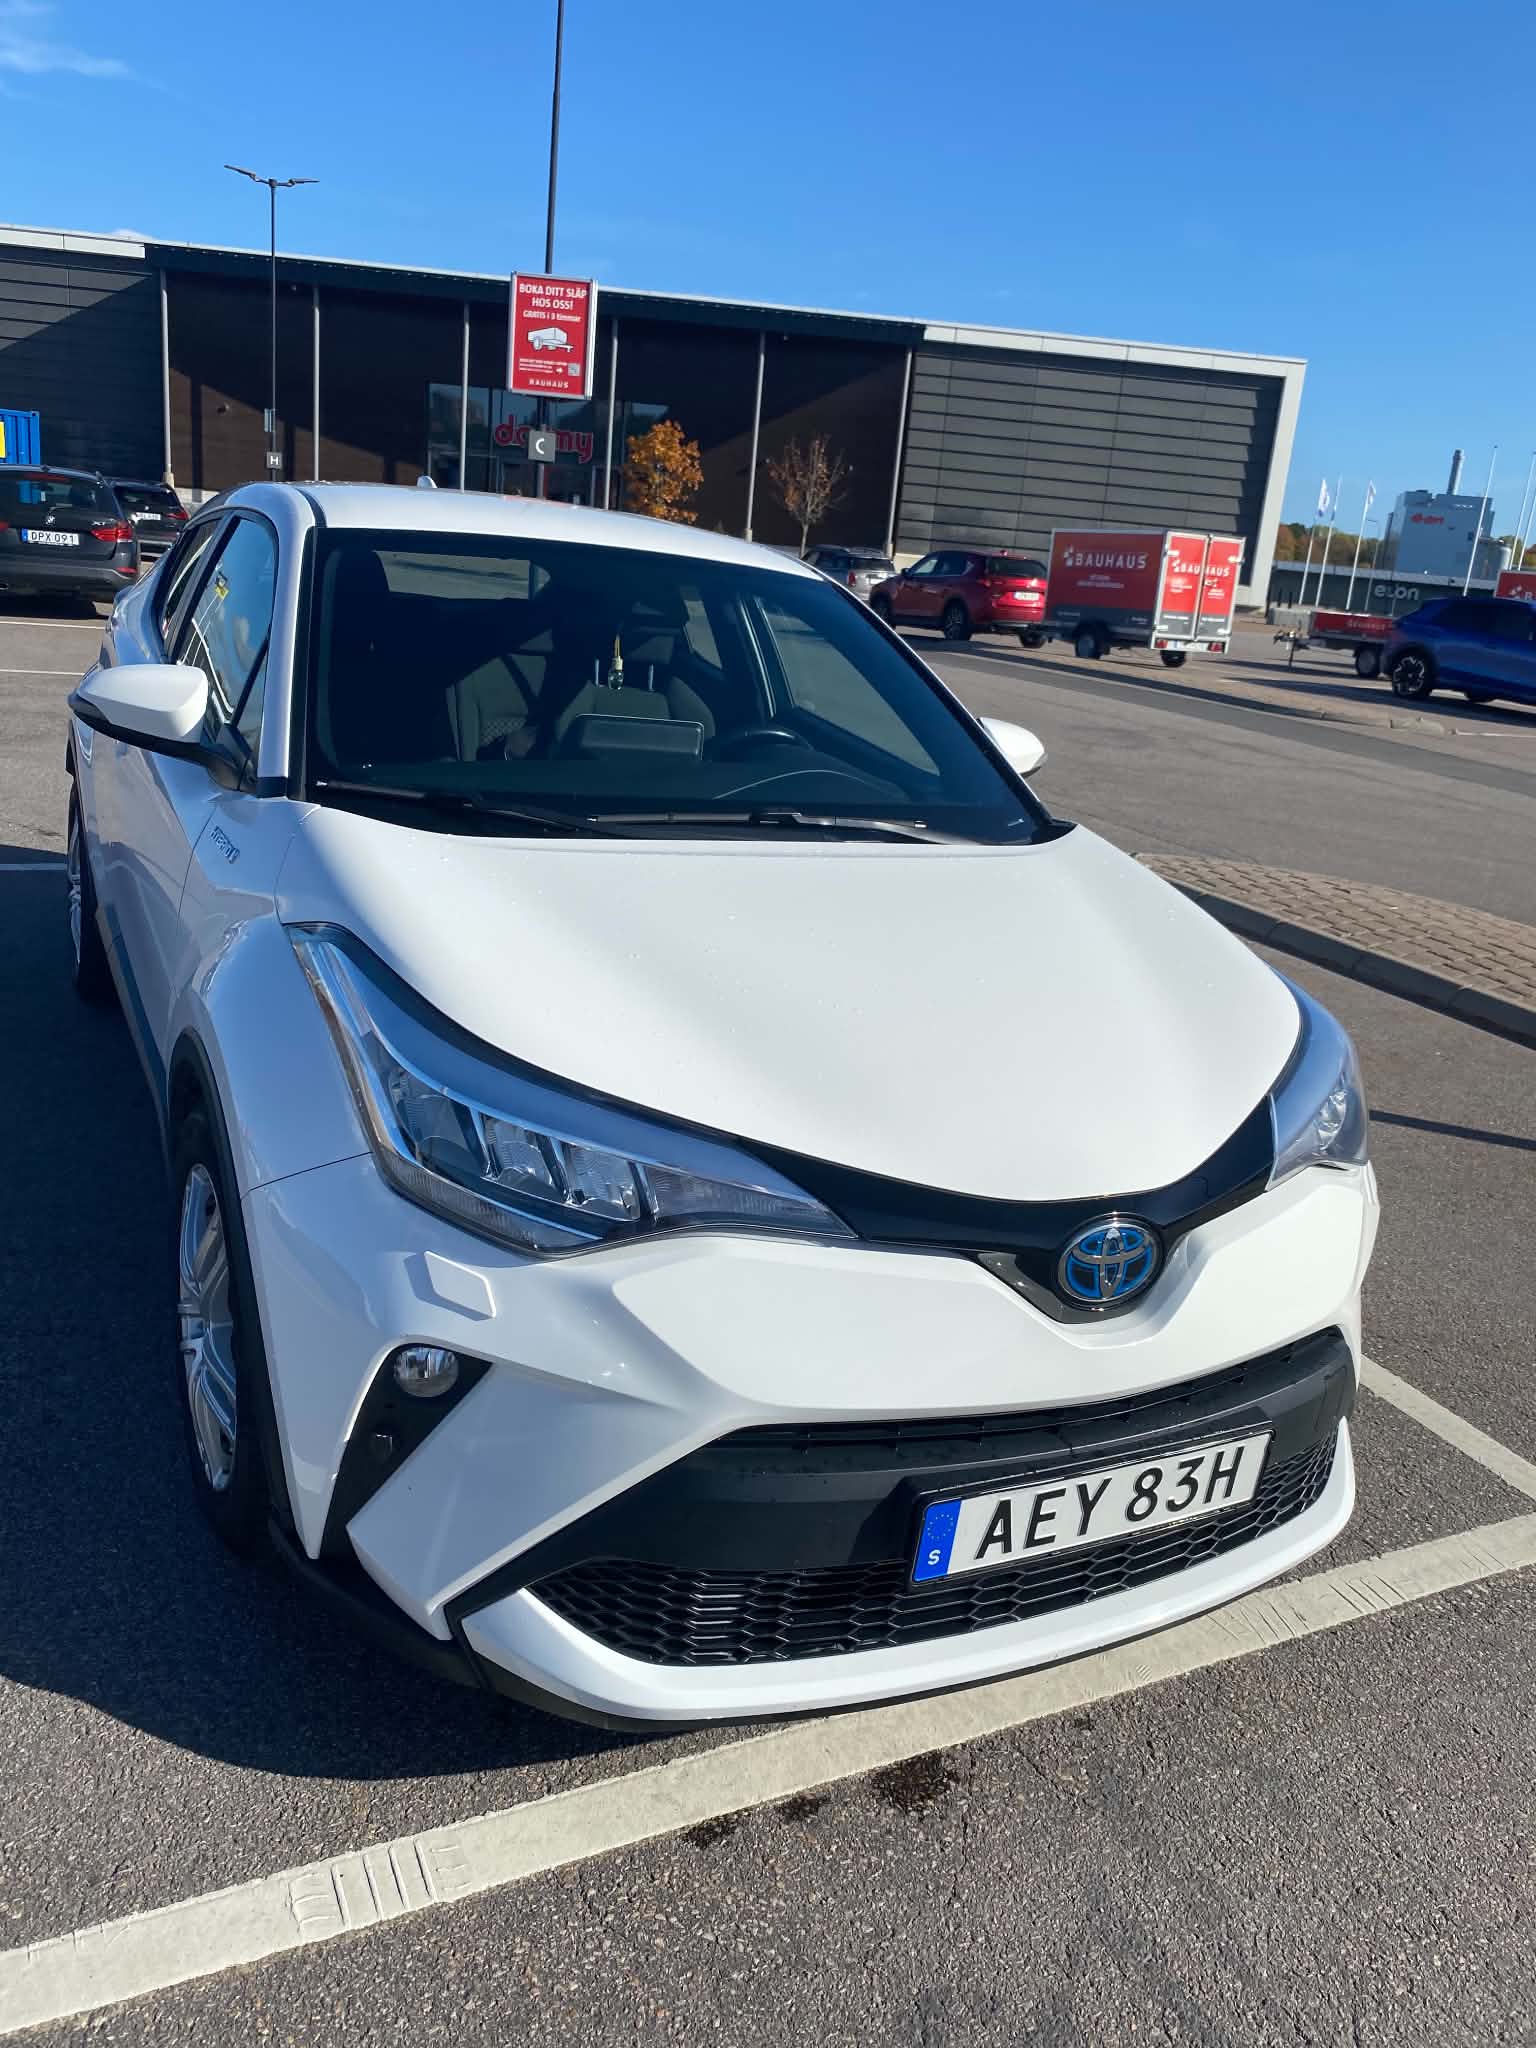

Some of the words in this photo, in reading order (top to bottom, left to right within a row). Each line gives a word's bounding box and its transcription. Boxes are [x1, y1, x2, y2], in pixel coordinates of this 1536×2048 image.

[519, 283, 544, 295] BOKA
[545, 285, 565, 297] DITT
[565, 287, 588, 299] SLÄP
[531, 297, 551, 308] HOS
[552, 299, 574, 310] OSS!
[528, 378, 569, 389] BAUHAUS
[494, 414, 593, 464] domy
[535, 437, 545, 455] C
[270, 455, 279, 466] H
[30, 532, 53, 543] DPX
[54, 533, 76, 545] 091
[1074, 551, 1149, 570] BAUHAUS
[974, 1476, 1113, 1561] AEY
[1125, 1444, 1246, 1523] 83H
[927, 1549, 941, 1566] S
